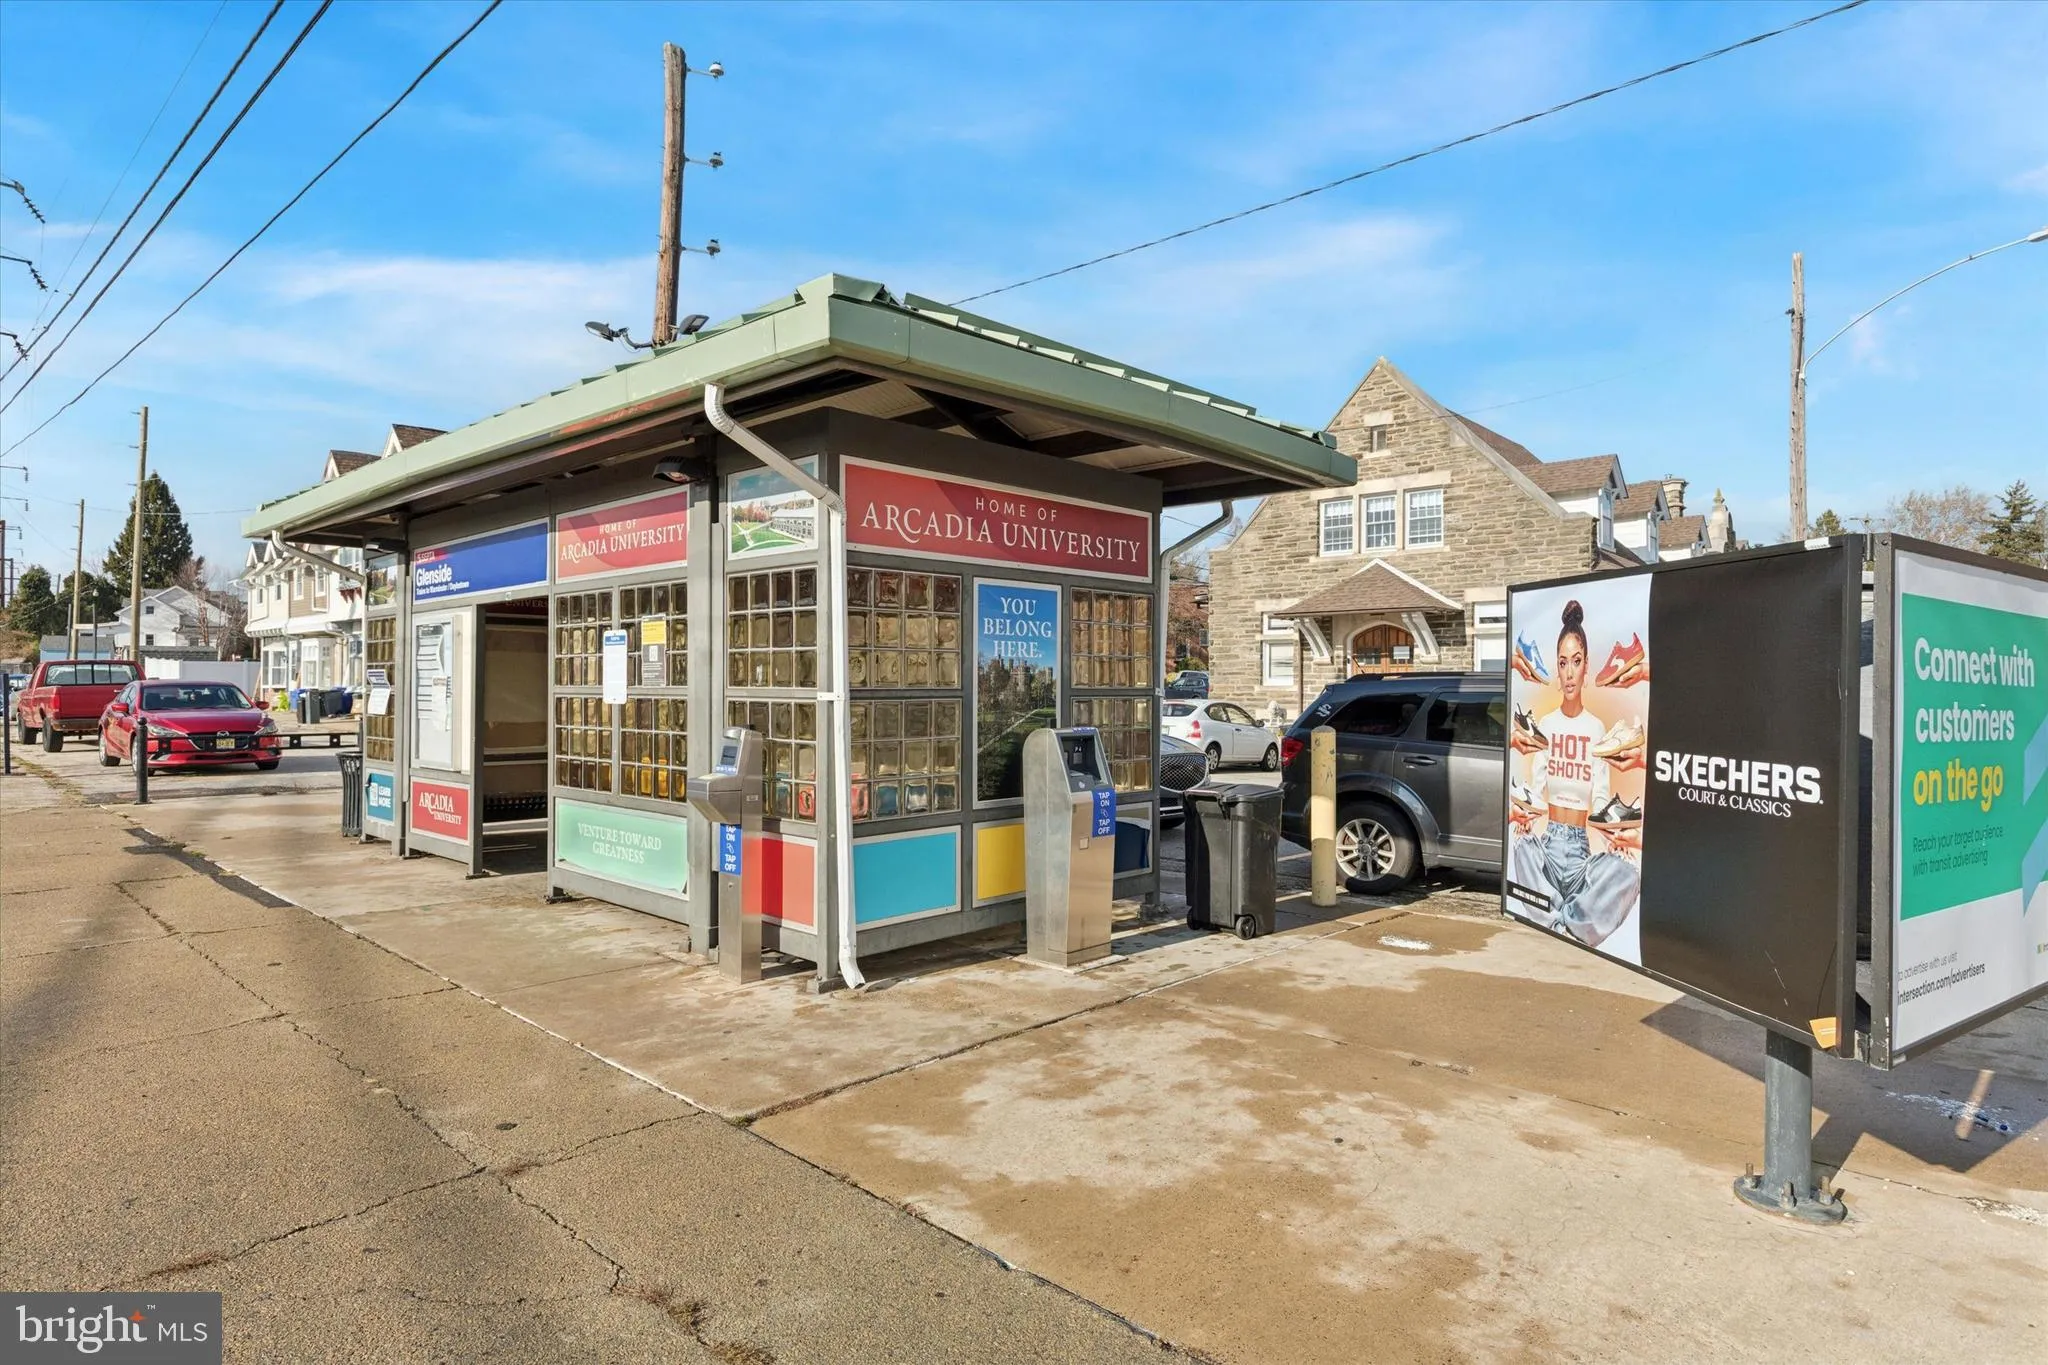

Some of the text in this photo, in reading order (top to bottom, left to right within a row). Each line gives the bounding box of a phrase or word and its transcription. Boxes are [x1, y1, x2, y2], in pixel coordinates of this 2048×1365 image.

[976, 496, 1057, 522] HOME OF
[600, 519, 637, 535] HOME OF
[861, 501, 1141, 563] ARCADIA UNIVERSITY
[561, 523, 685, 564] ARCADIA UNIVERSITY
[416, 563, 453, 587] Glenside
[1000, 596, 1037, 616] YOU
[983, 617, 1053, 638] BELONG
[993, 640, 1042, 658] HERE.
[1914, 636, 2035, 688] Connect with
[1915, 701, 2015, 743] customers
[1551, 733, 1591, 761] HOT
[1547, 759, 1592, 782] SHOTS
[1098, 791, 1110, 800] TAP
[1913, 758, 2003, 812] on the go
[418, 791, 454, 815] ARCADIA
[1100, 799, 1110, 807] ON
[1678, 787, 1791, 818] COURT & CLASSICS
[433, 811, 462, 825] UNIVERSITY
[725, 825, 736, 833] TAP
[1098, 819, 1110, 827] TAP
[577, 822, 662, 851] VENTURE TOWARD
[725, 833, 735, 842] ON
[1098, 827, 1110, 835] OFF
[1913, 835, 1936, 853] Reach
[1937, 833, 1953, 852] your
[1954, 829, 1973, 849] target
[592, 840, 645, 864] GREATNESS
[725, 854, 736, 863] TAP
[1912, 848, 1988, 877] with transit advertising
[724, 863, 736, 872] OFF
